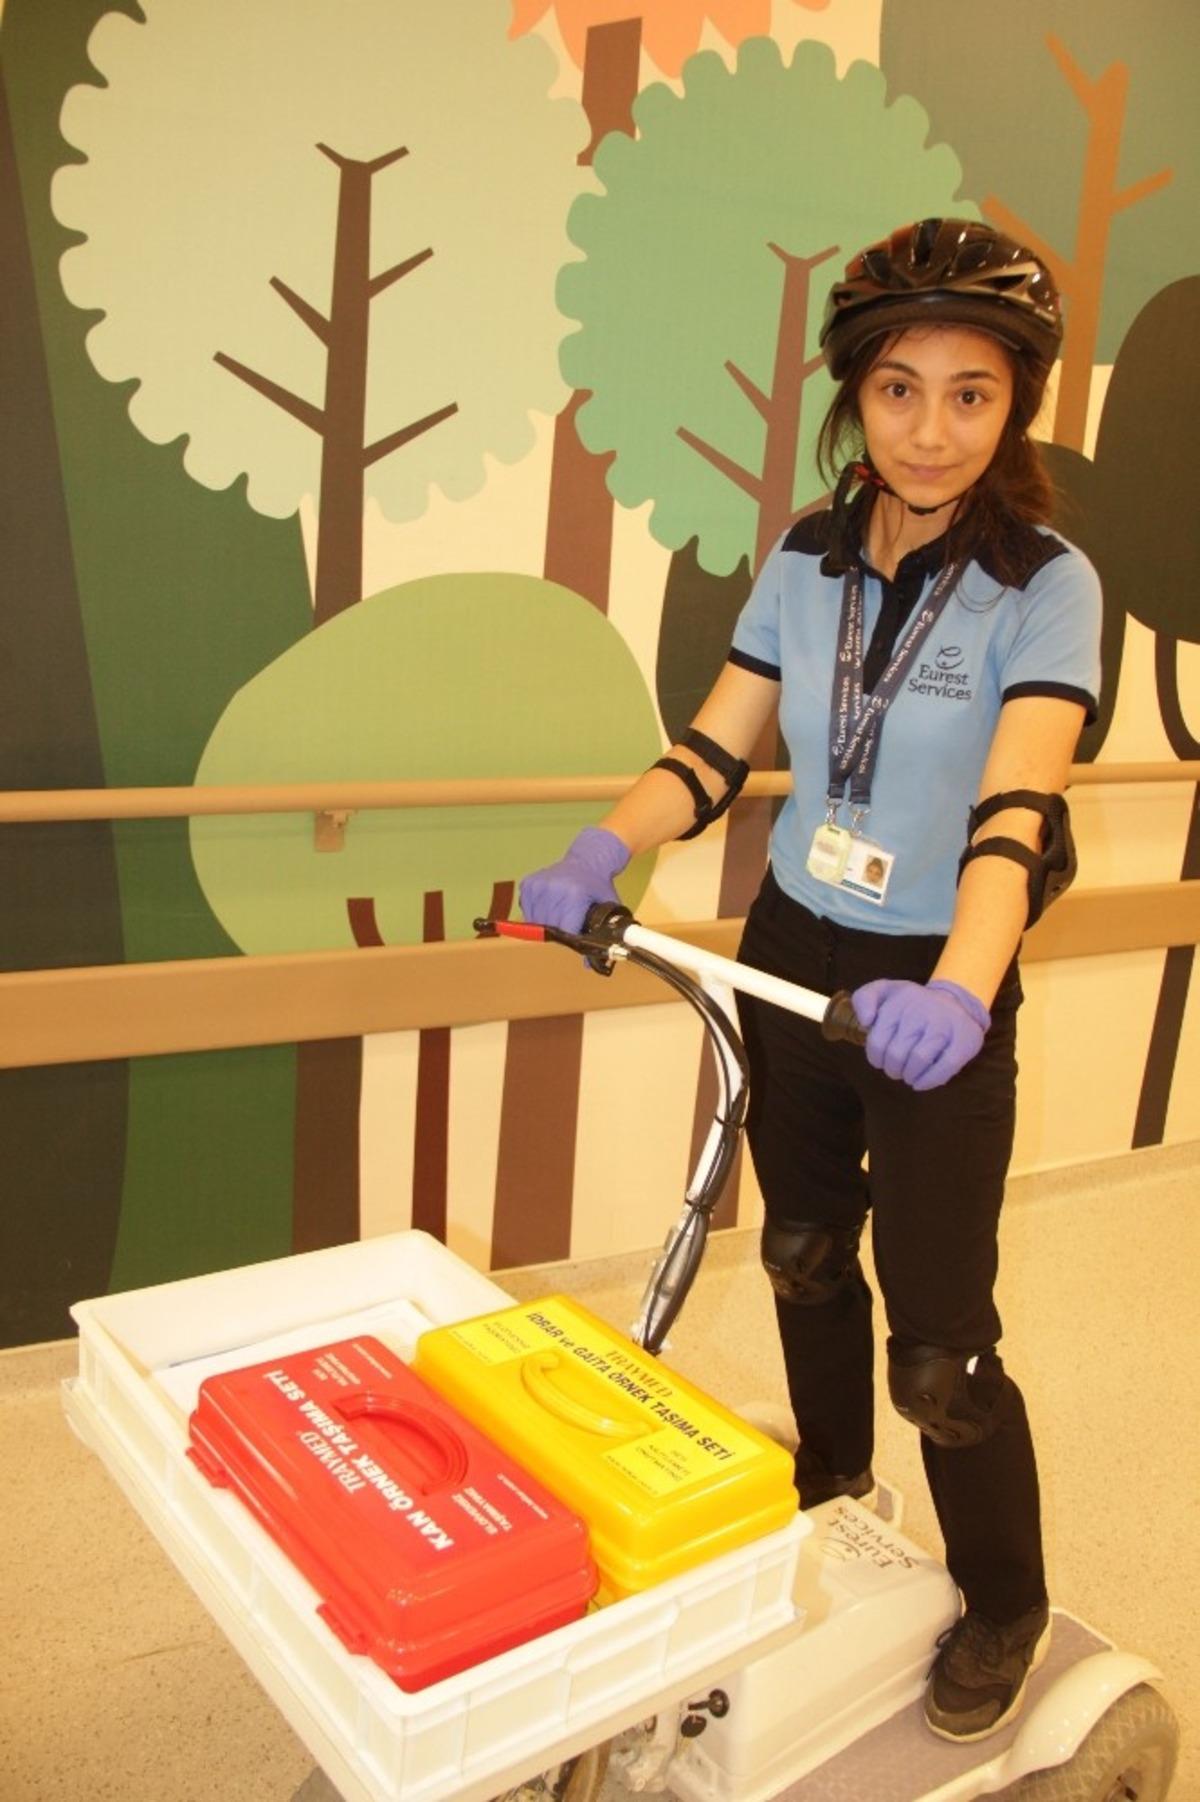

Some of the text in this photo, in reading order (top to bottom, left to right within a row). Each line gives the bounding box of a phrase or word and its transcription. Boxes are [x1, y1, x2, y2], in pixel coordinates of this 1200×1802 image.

[907, 678, 972, 700] Services
[918, 664, 969, 685] Eurest
[837, 676, 850, 743] Eurest Services
[261, 1368, 306, 1402] SETİ
[298, 1399, 359, 1456] TAŞIMA
[608, 1372, 654, 1404] ÖRNEK
[650, 1401, 700, 1438] TAŞIMA
[696, 1436, 736, 1461] SETİ
[351, 1454, 414, 1512] ÖRNEK
[405, 1509, 455, 1551] KAN
[828, 1519, 892, 1567] Eurest
[834, 1506, 920, 1568] Services
